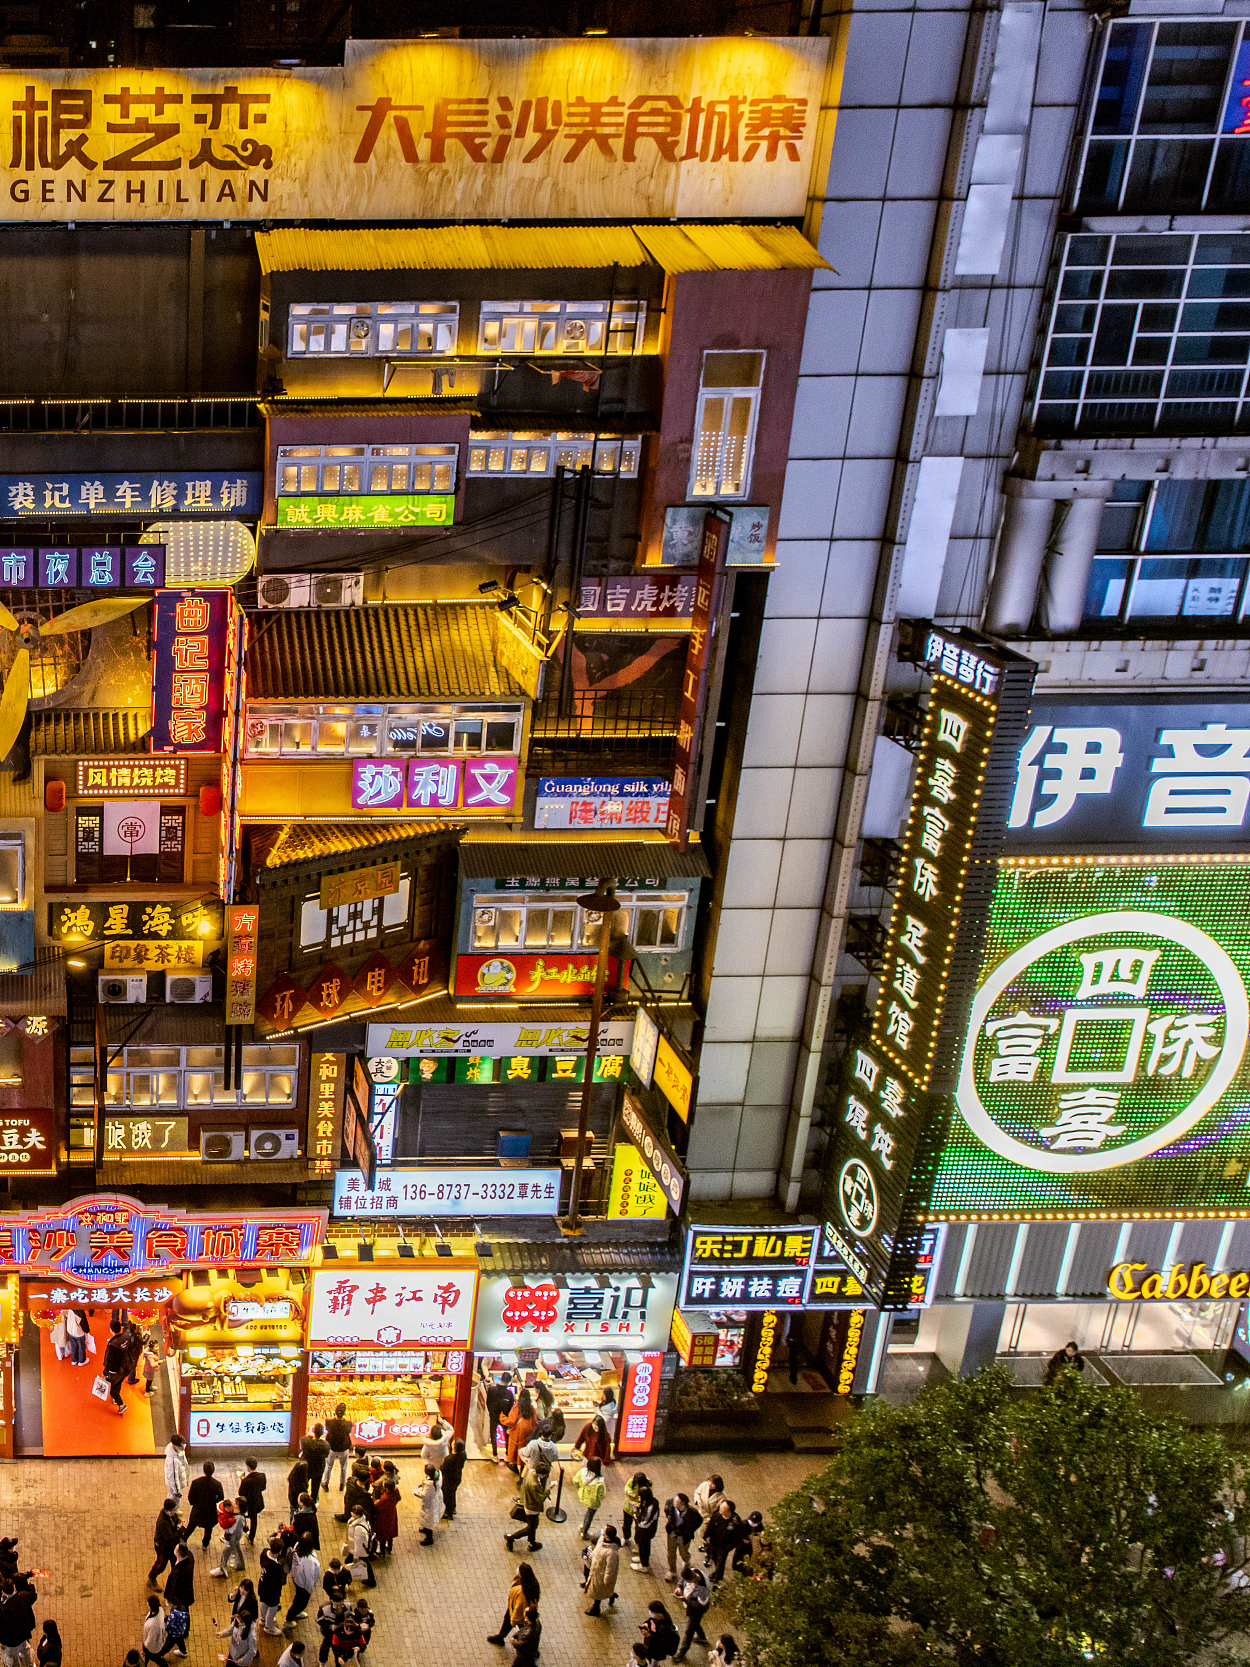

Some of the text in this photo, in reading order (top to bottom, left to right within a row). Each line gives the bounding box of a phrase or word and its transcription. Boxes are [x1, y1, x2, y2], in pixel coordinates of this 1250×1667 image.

[12, 86, 273, 172] 根芝恋
[11, 178, 270, 204] GENZHILIAN
[86, 767, 177, 787] 风情烧烤
[357, 763, 514, 805] 莎利文
[544, 779, 620, 796] Guanglong
[623, 779, 648, 793] silk
[110, 944, 196, 965] 印象茶楼
[1076, 949, 1160, 999] 四
[275, 955, 430, 1019] 环球电讯
[985, 1009, 1223, 1082] 富 侨
[506, 1056, 624, 1080] 臭豆腐
[4, 1118, 30, 1127] TOFU
[1040, 1088, 1127, 1150] 喜
[347, 1177, 391, 1193] 美城
[403, 1182, 555, 1201] 136-8737-3332 覃先生
[338, 1195, 399, 1211] 铺位招商
[564, 1321, 646, 1333] XISHI
